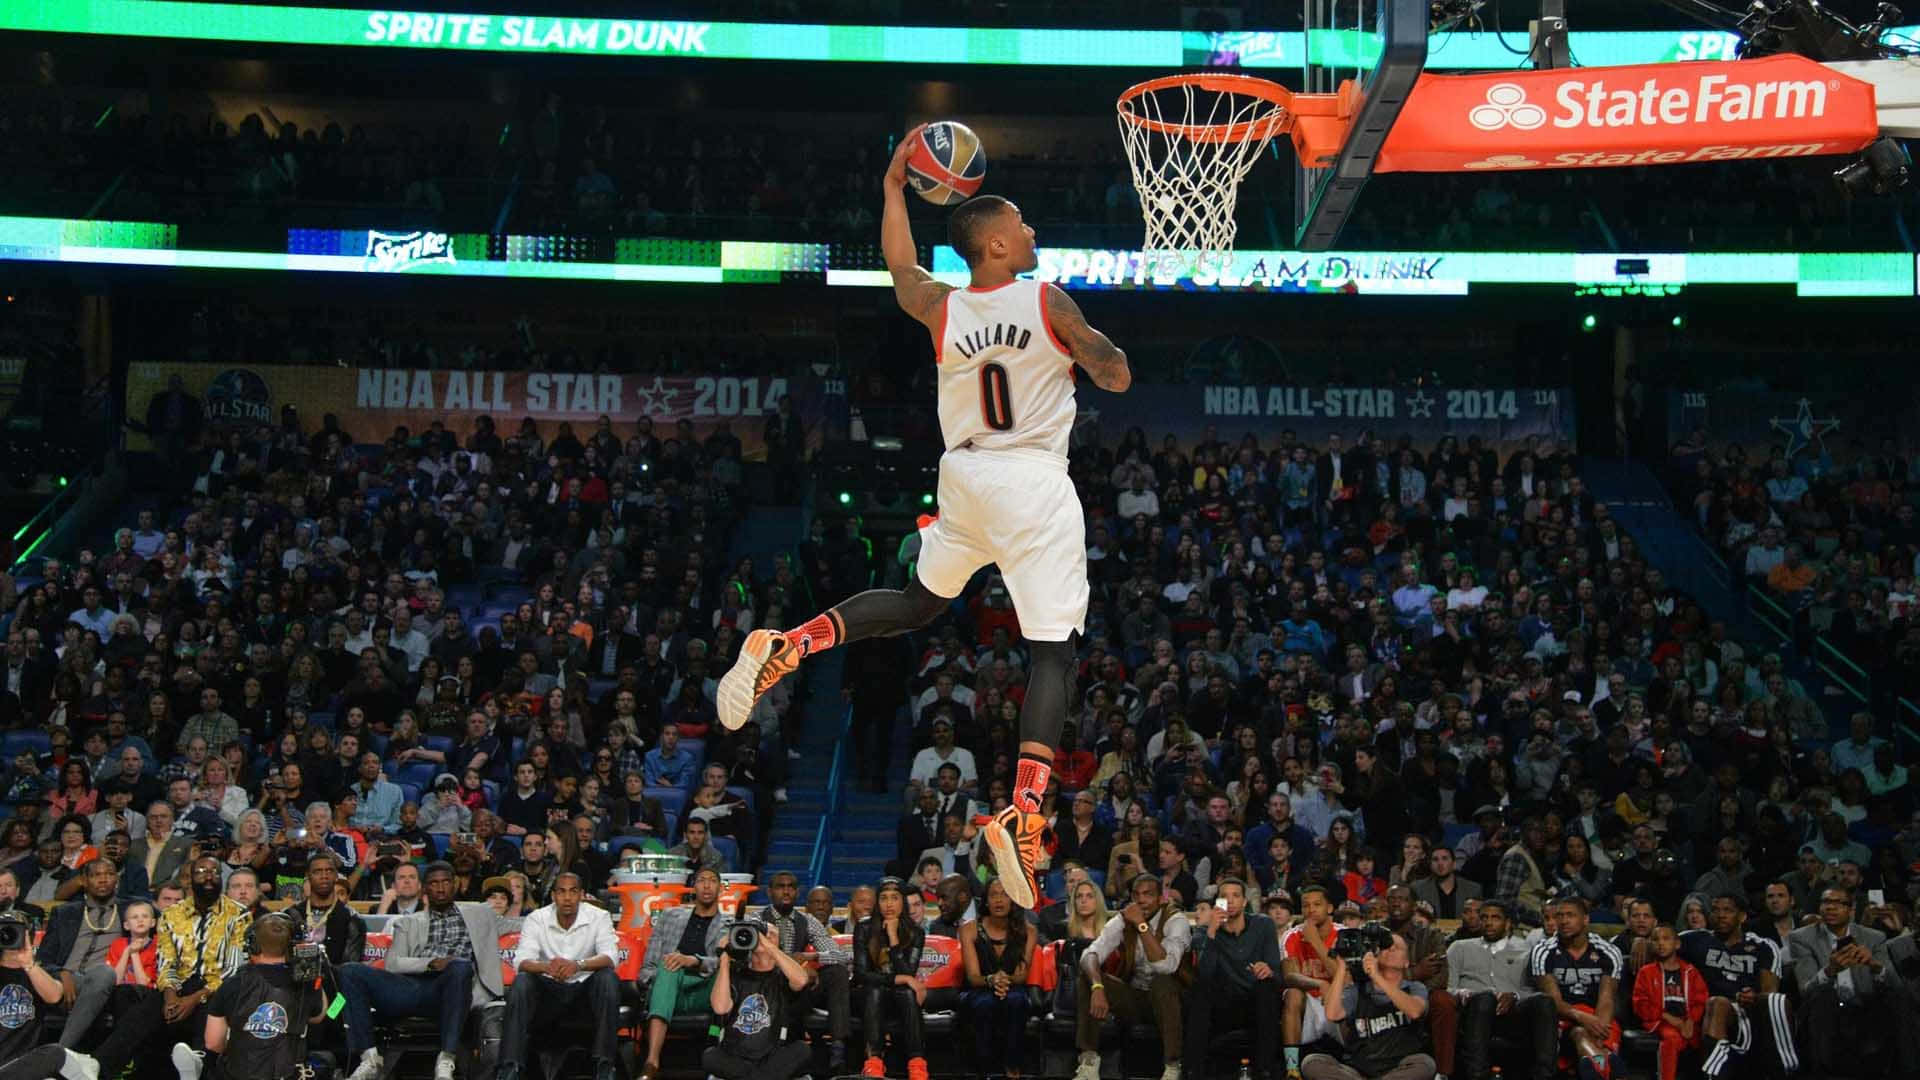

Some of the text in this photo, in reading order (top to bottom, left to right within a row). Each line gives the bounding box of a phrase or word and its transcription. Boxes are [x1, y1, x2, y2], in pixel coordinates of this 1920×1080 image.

[365, 11, 711, 52] SPRITE SLAM DUNK
[1036, 249, 1445, 288] SPRITE SLAM DUNK
[955, 323, 1032, 360] LILLARD
[356, 368, 788, 416] NBA ALL STAR 2014
[979, 361, 1014, 431] 0
[1204, 386, 1519, 419] NBA ALL-STAR 2014
[1705, 948, 1758, 975] EAST
[1369, 1011, 1397, 1035] NBA
